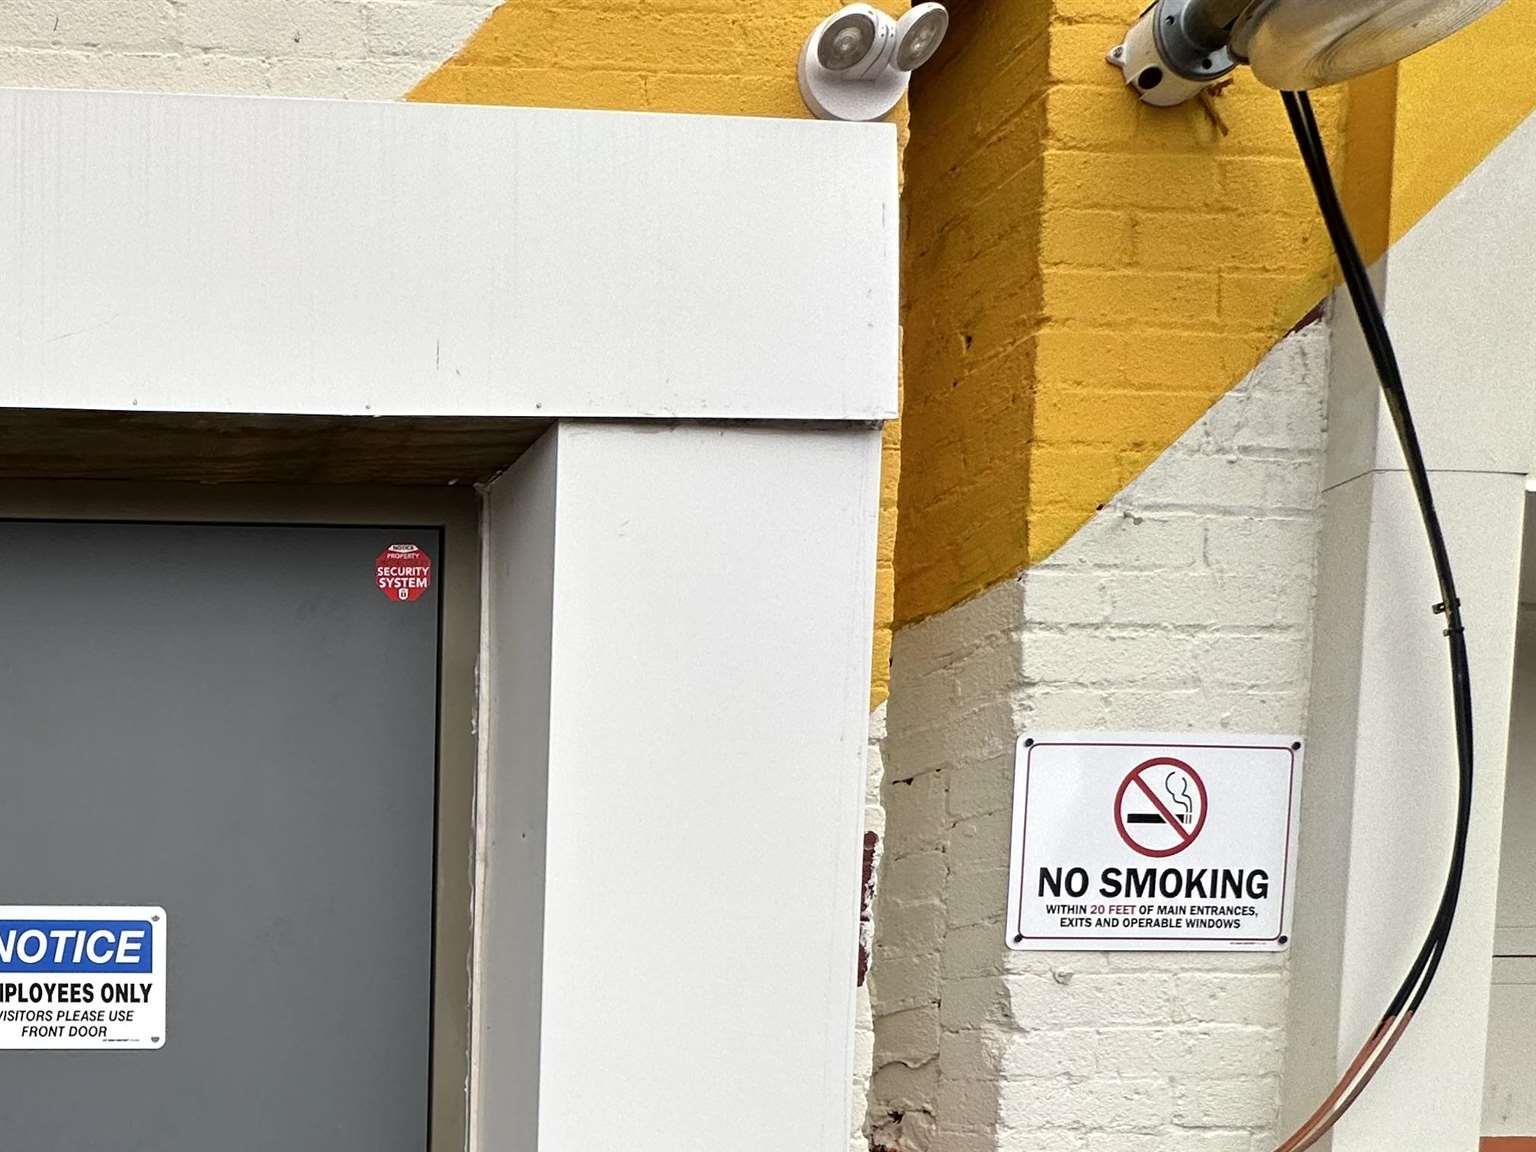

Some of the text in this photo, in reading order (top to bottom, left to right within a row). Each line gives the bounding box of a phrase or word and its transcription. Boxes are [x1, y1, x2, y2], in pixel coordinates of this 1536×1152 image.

[377, 566, 429, 576] SECURITY
[379, 577, 427, 588] SYSTEM
[1038, 866, 1269, 899] NO SMOKING
[1046, 904, 1258, 917] WITHIN 20 FEET OF MAIN ENTRANCES,
[1059, 917, 1241, 929] EXITS AND OPERABLE WINDOWS
[100, 983, 153, 1003] ONLY
[56, 1010, 106, 1022] PLEASE
[108, 1010, 135, 1022] USE
[21, 1026, 107, 1037] FRONT DOOR
